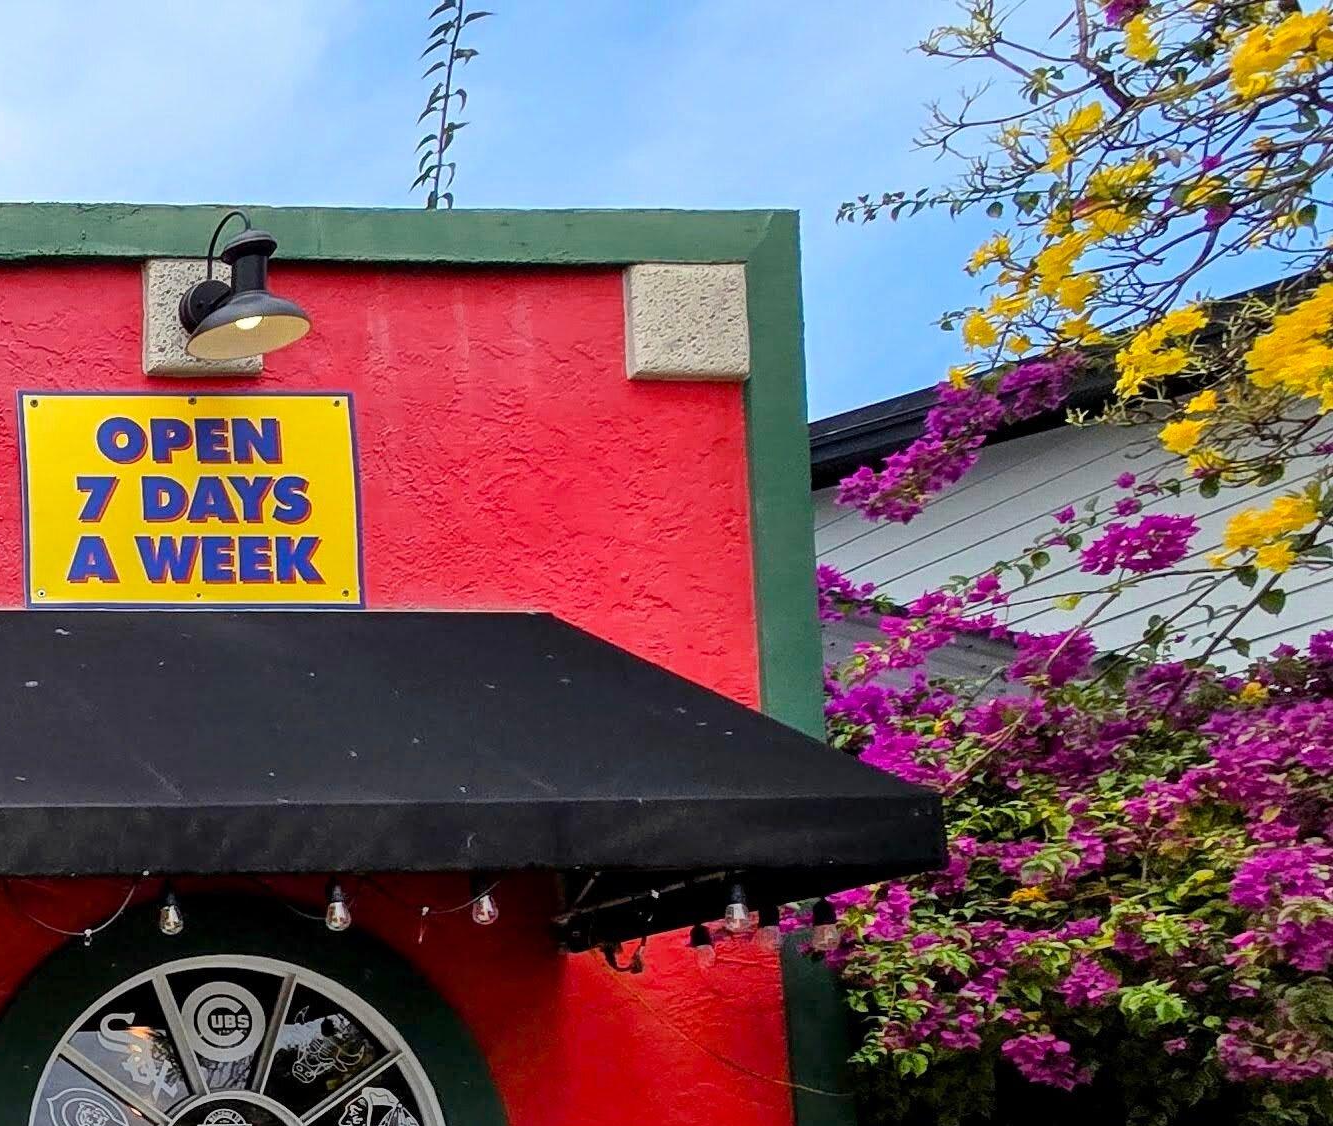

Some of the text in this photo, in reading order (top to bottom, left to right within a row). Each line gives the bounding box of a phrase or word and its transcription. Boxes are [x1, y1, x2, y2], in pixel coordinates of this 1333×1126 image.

[96, 417, 282, 464] OPEN
[76, 475, 312, 525] 7 DAYS
[66, 536, 325, 585] A WEEK
